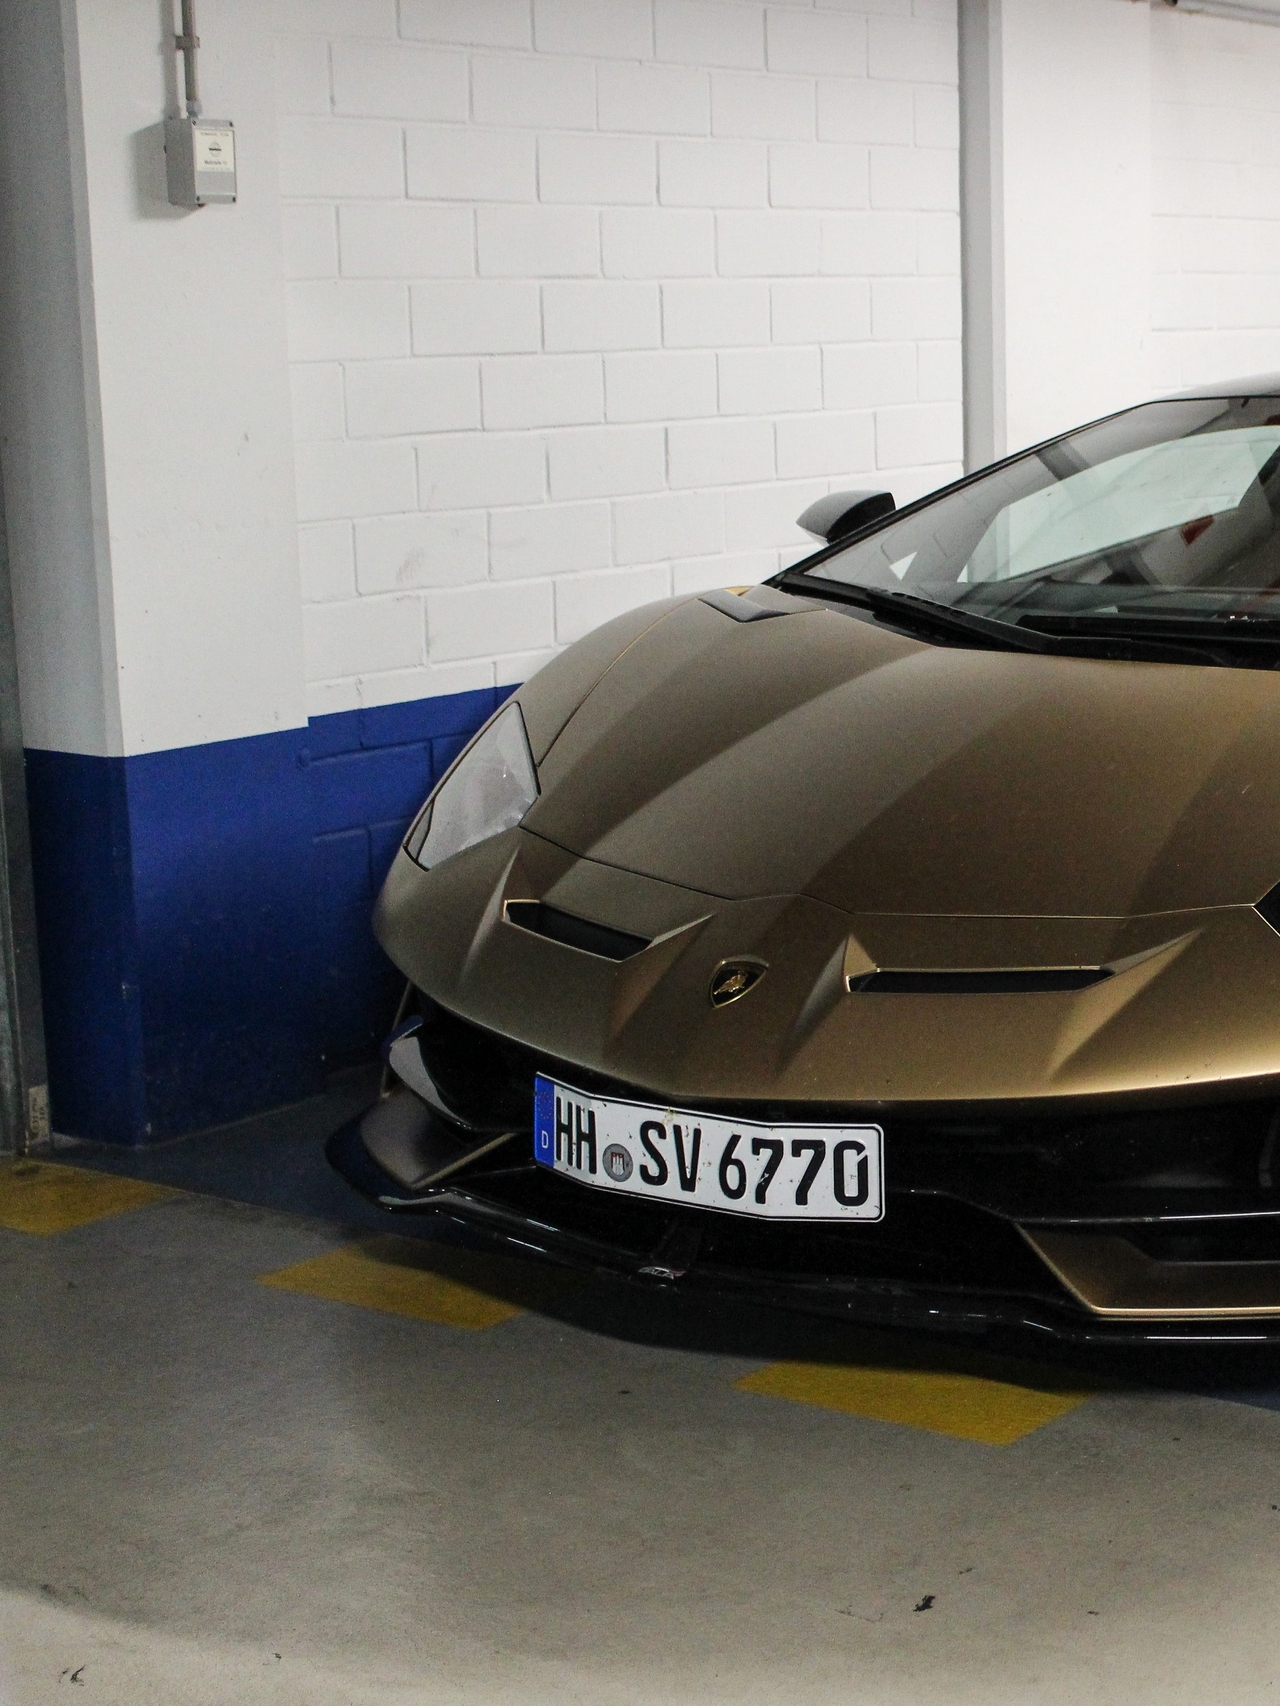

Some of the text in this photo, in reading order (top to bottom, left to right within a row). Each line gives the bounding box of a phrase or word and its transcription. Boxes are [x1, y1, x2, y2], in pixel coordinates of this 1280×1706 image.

[541, 1130, 549, 1149] D
[556, 1096, 868, 1207] HH SV 6770
